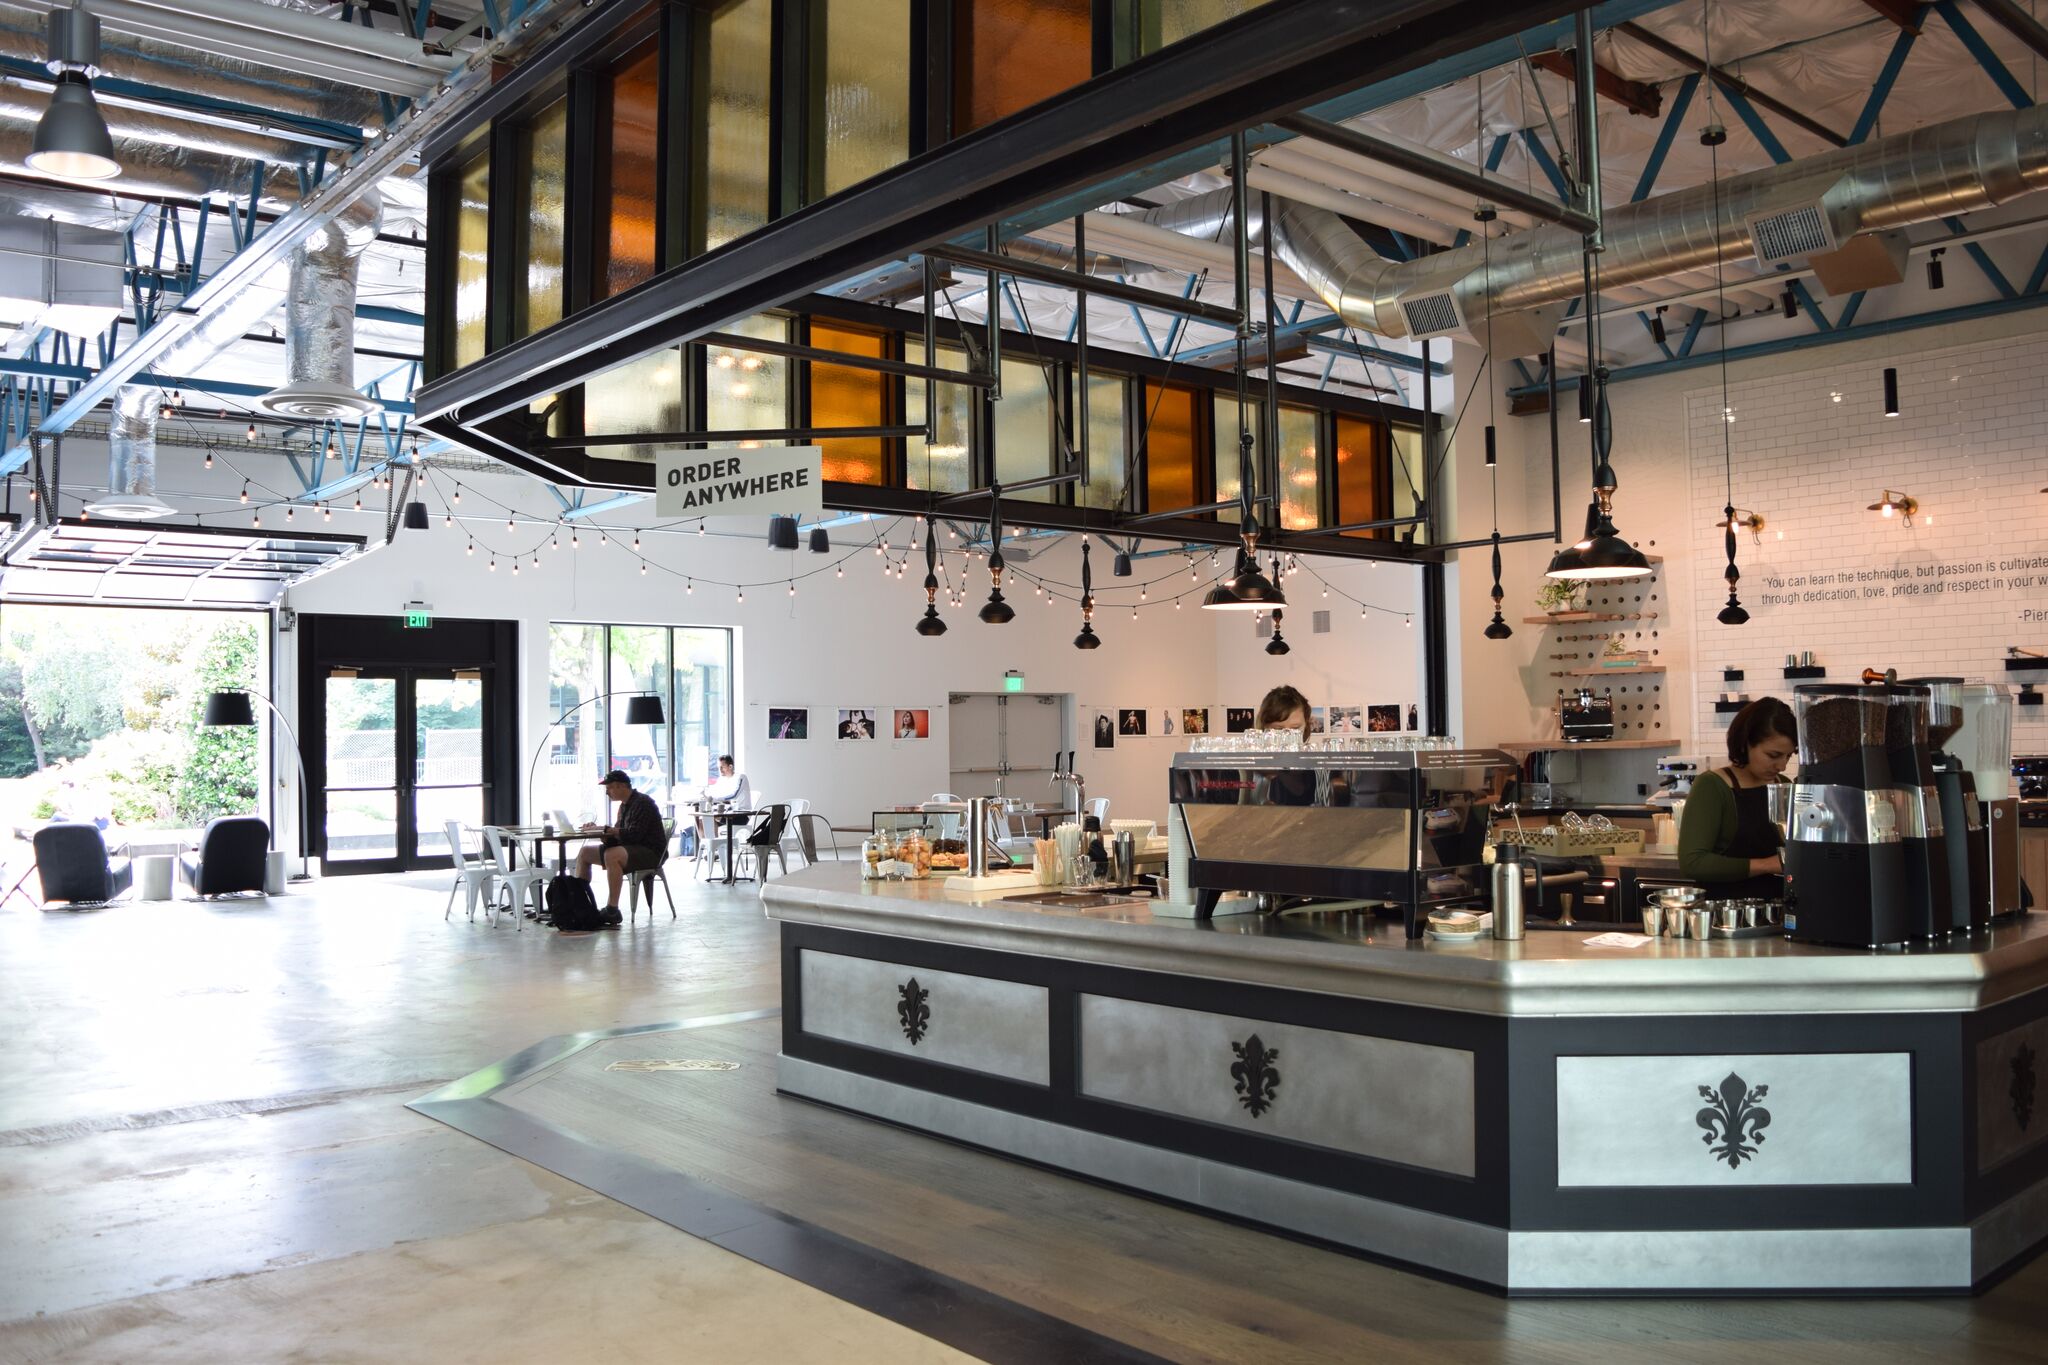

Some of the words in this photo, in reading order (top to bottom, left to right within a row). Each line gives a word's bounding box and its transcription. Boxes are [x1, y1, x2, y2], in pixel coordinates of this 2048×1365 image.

[667, 457, 741, 487] ORDER
[682, 467, 809, 510] ANYWHERE
[1788, 576, 1806, 588] can
[1809, 571, 1835, 585] learn
[1838, 571, 1854, 583] the
[1857, 567, 1912, 582] technique,
[1917, 564, 1934, 577] but
[1938, 561, 1982, 578] passion
[1986, 559, 1996, 572] is
[2000, 556, 2048, 571] cultivate
[1761, 592, 1800, 606] through
[1803, 587, 1860, 602] dedication,
[1892, 582, 1919, 598] pride
[1923, 580, 1943, 594] and
[1947, 578, 1990, 593] respect
[1993, 577, 2003, 589] in
[2007, 575, 2034, 591] your
[409, 614, 427, 627] EXIT
